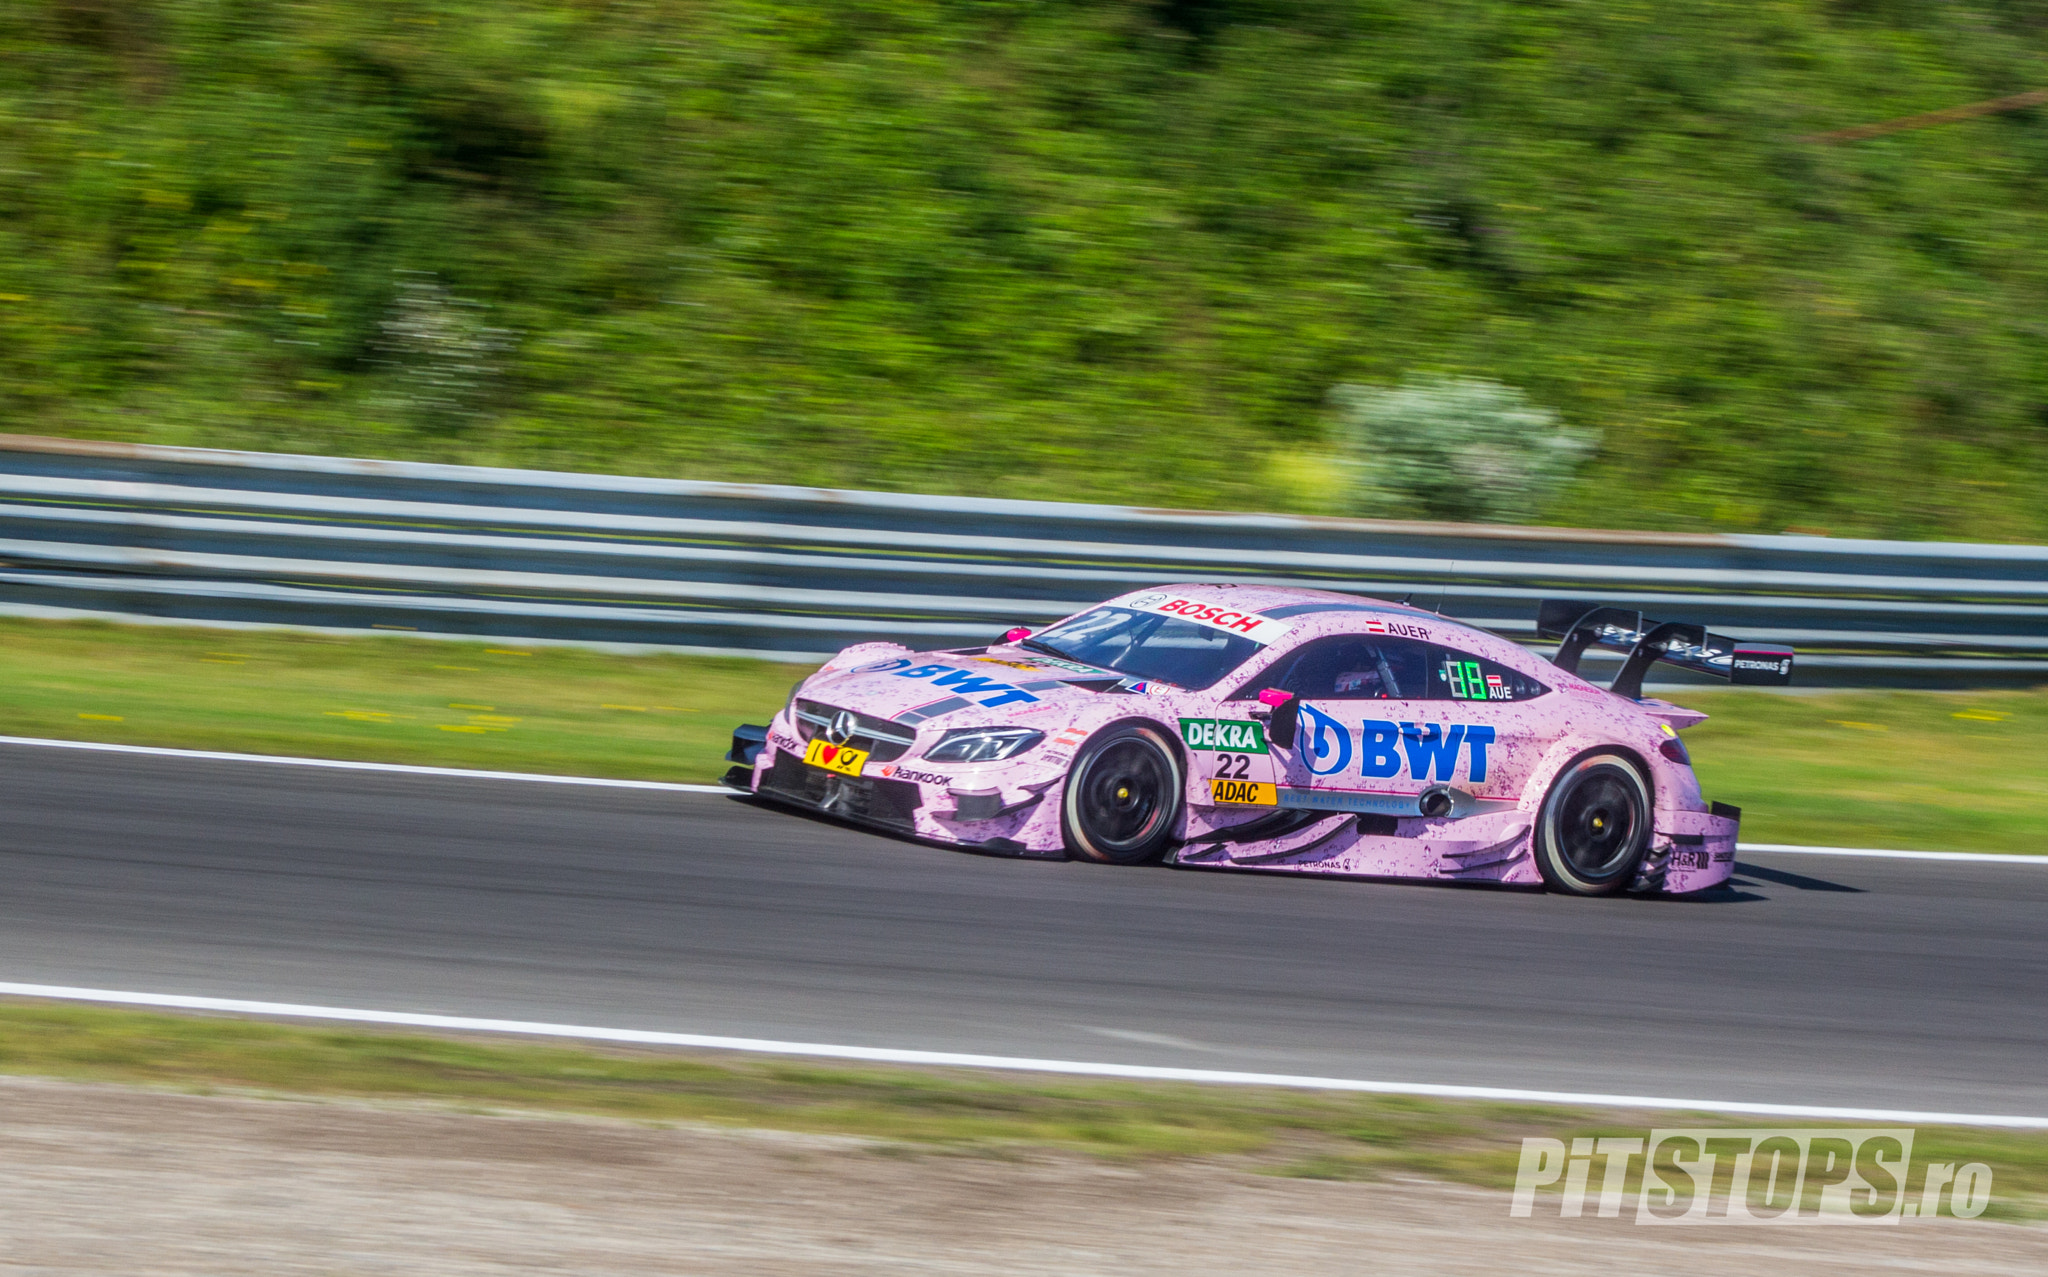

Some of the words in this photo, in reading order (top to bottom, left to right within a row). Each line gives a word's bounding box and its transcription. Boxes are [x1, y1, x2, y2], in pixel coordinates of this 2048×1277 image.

[1041, 610, 1132, 641] 22
[1158, 600, 1264, 632] BOSCH
[1388, 622, 1429, 640] AUER
[1734, 659, 1779, 671] PETRONAS
[890, 664, 1041, 708] BWT
[1489, 686, 1512, 699] AUE
[1188, 723, 1257, 748] DEKRA
[1361, 719, 1496, 783] BWT
[1215, 753, 1250, 780] 22
[1213, 782, 1259, 802] ADAC
[1299, 860, 1341, 869] PETRONAS
[1672, 851, 1695, 866] H&R
